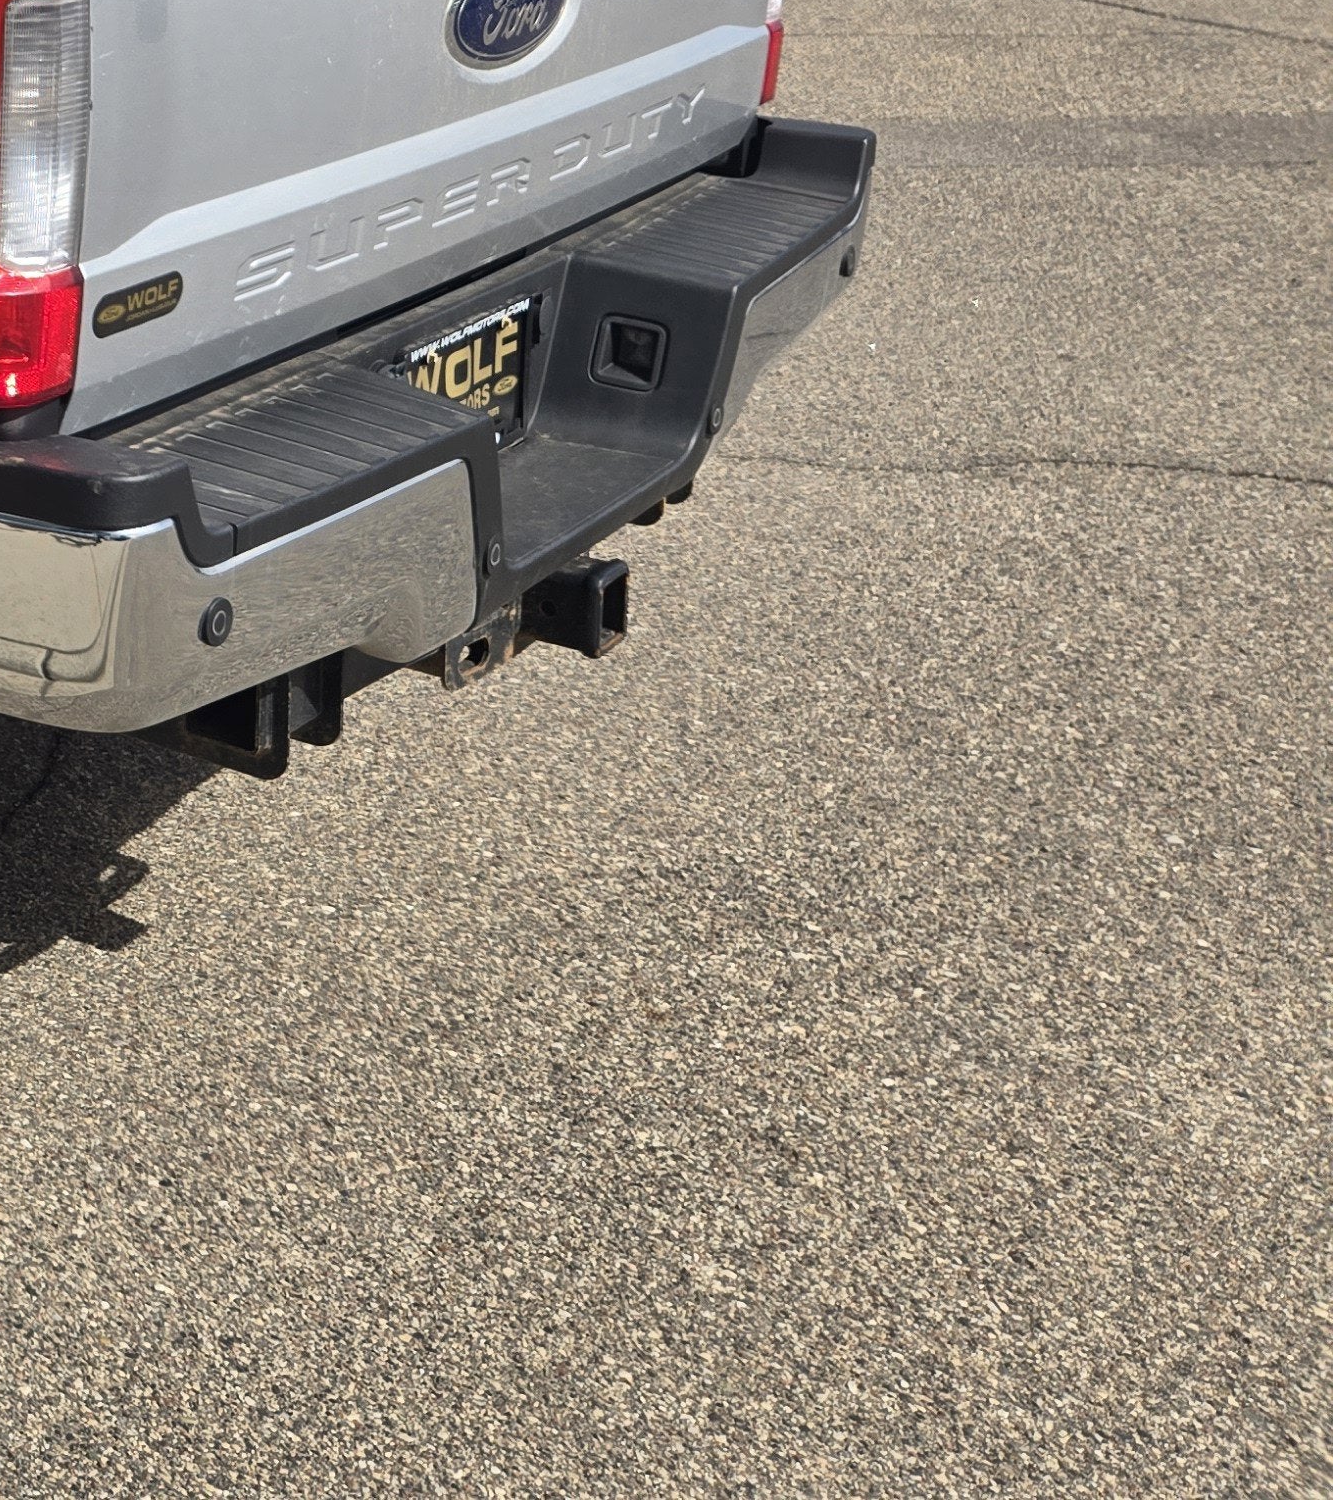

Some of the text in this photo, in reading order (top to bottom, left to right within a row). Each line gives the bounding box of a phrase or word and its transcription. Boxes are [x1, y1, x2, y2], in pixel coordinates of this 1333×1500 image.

[234, 83, 708, 302] SUPER DUTY
[126, 278, 180, 311] WOLF
[407, 317, 519, 398] WOLF
